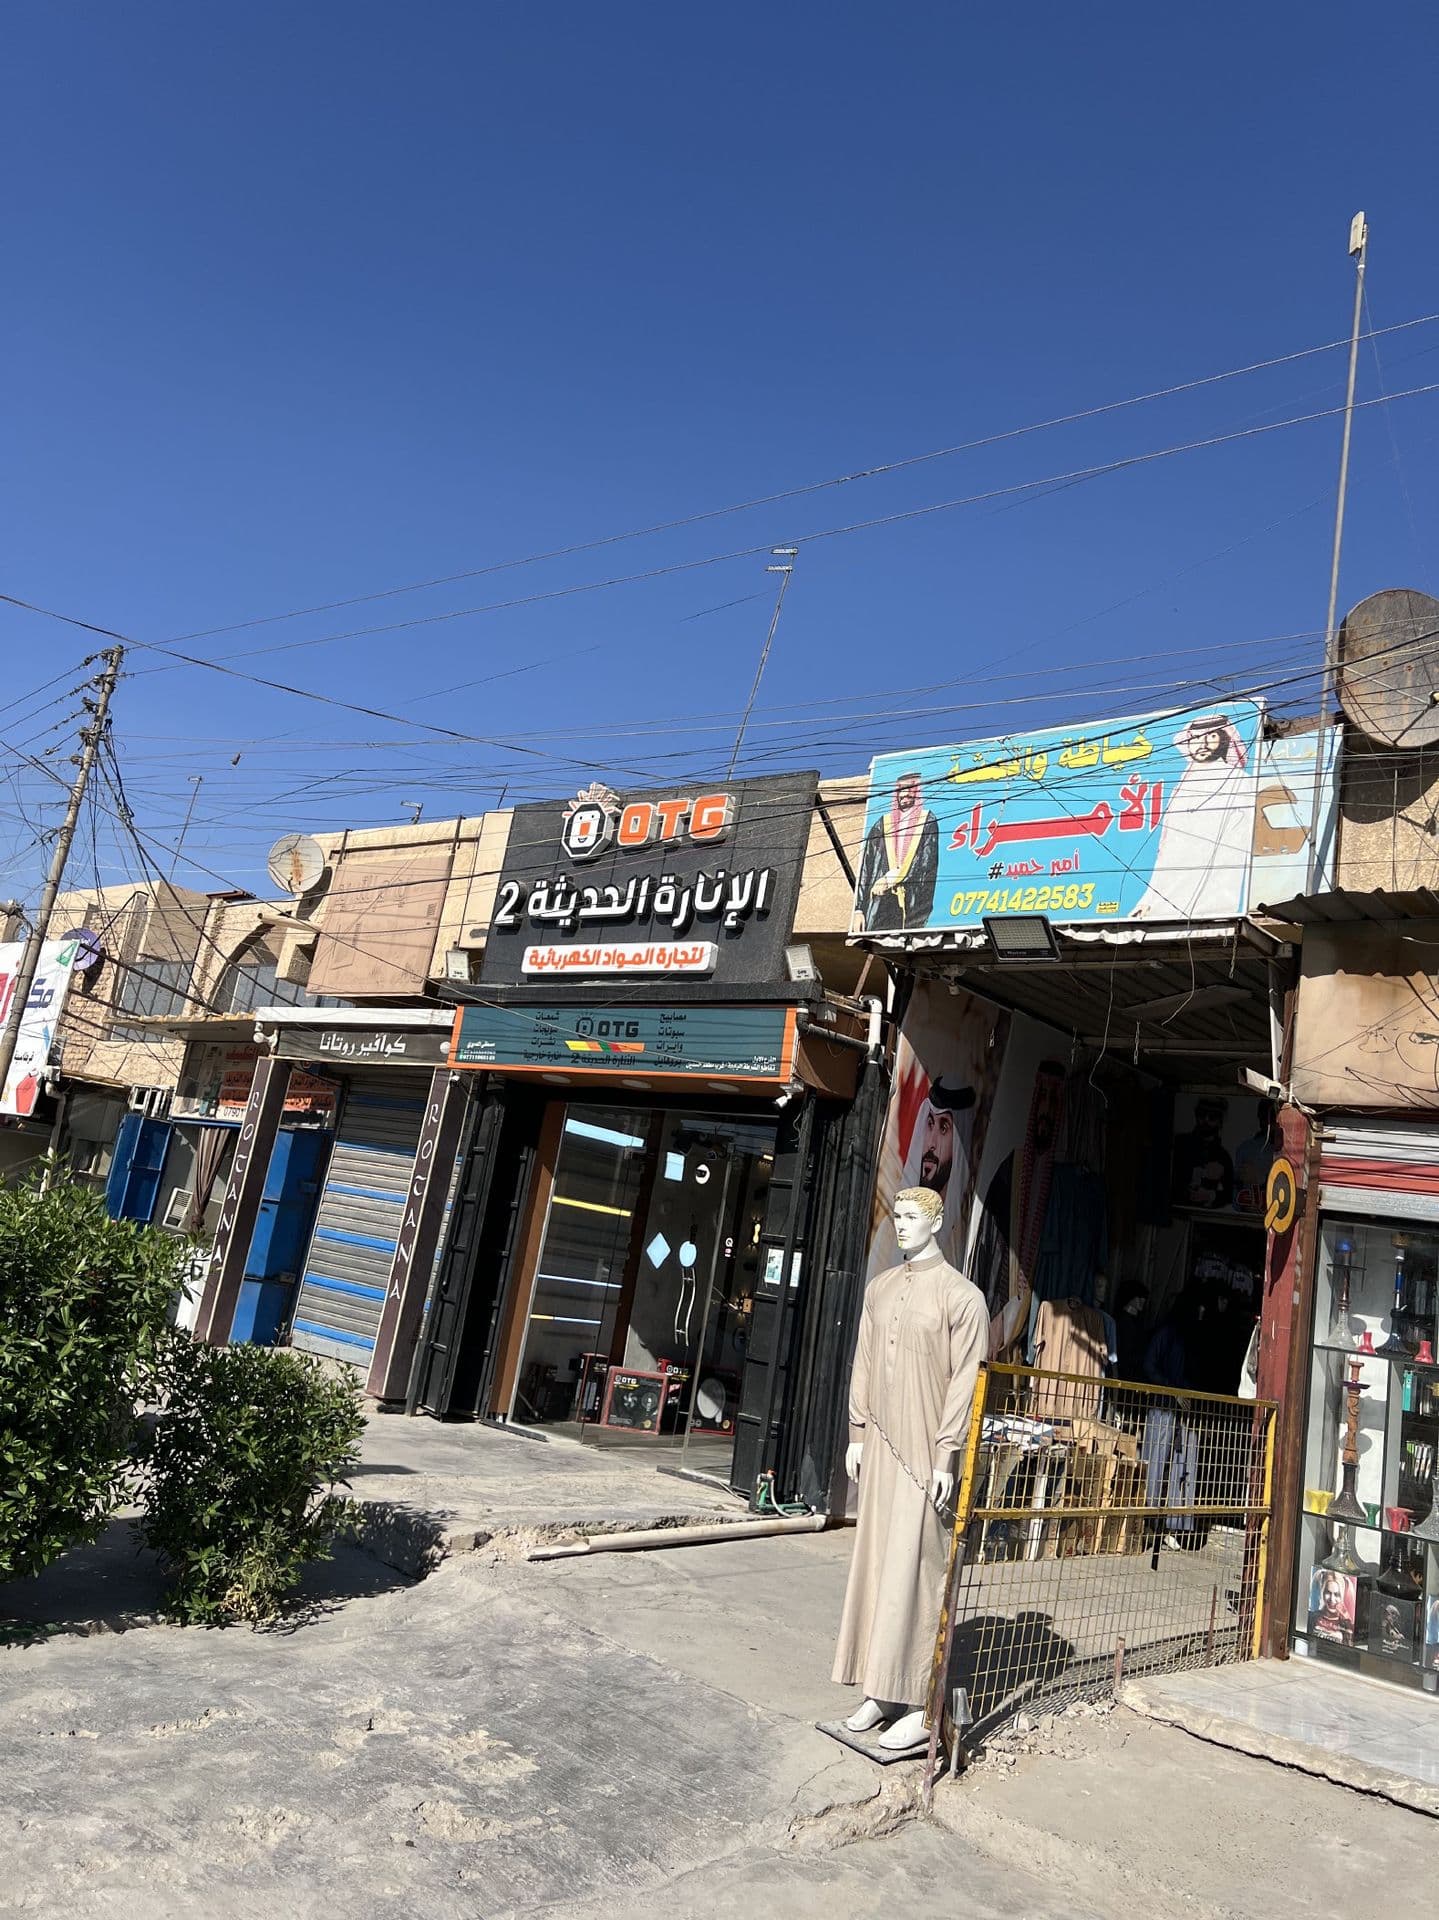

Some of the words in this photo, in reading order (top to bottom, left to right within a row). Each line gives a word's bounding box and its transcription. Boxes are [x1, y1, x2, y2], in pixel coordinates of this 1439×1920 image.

[1058, 727, 1154, 771] خياطة
[618, 793, 731, 847] OTG
[494, 880, 521, 926] 2
[527, 873, 652, 928] الحديثة
[950, 882, 1096, 916] 07741422583
[528, 948, 601, 970] الكهربائية
[602, 947, 655, 969] المواد
[656, 946, 704, 969] لتجارة
[319, 1033, 356, 1056] روتانا
[356, 1033, 406, 1058] كوافير
[598, 1021, 640, 1037] OTG
[212, 1090, 259, 1264] ROTANA
[389, 1102, 439, 1300] ROTANA
